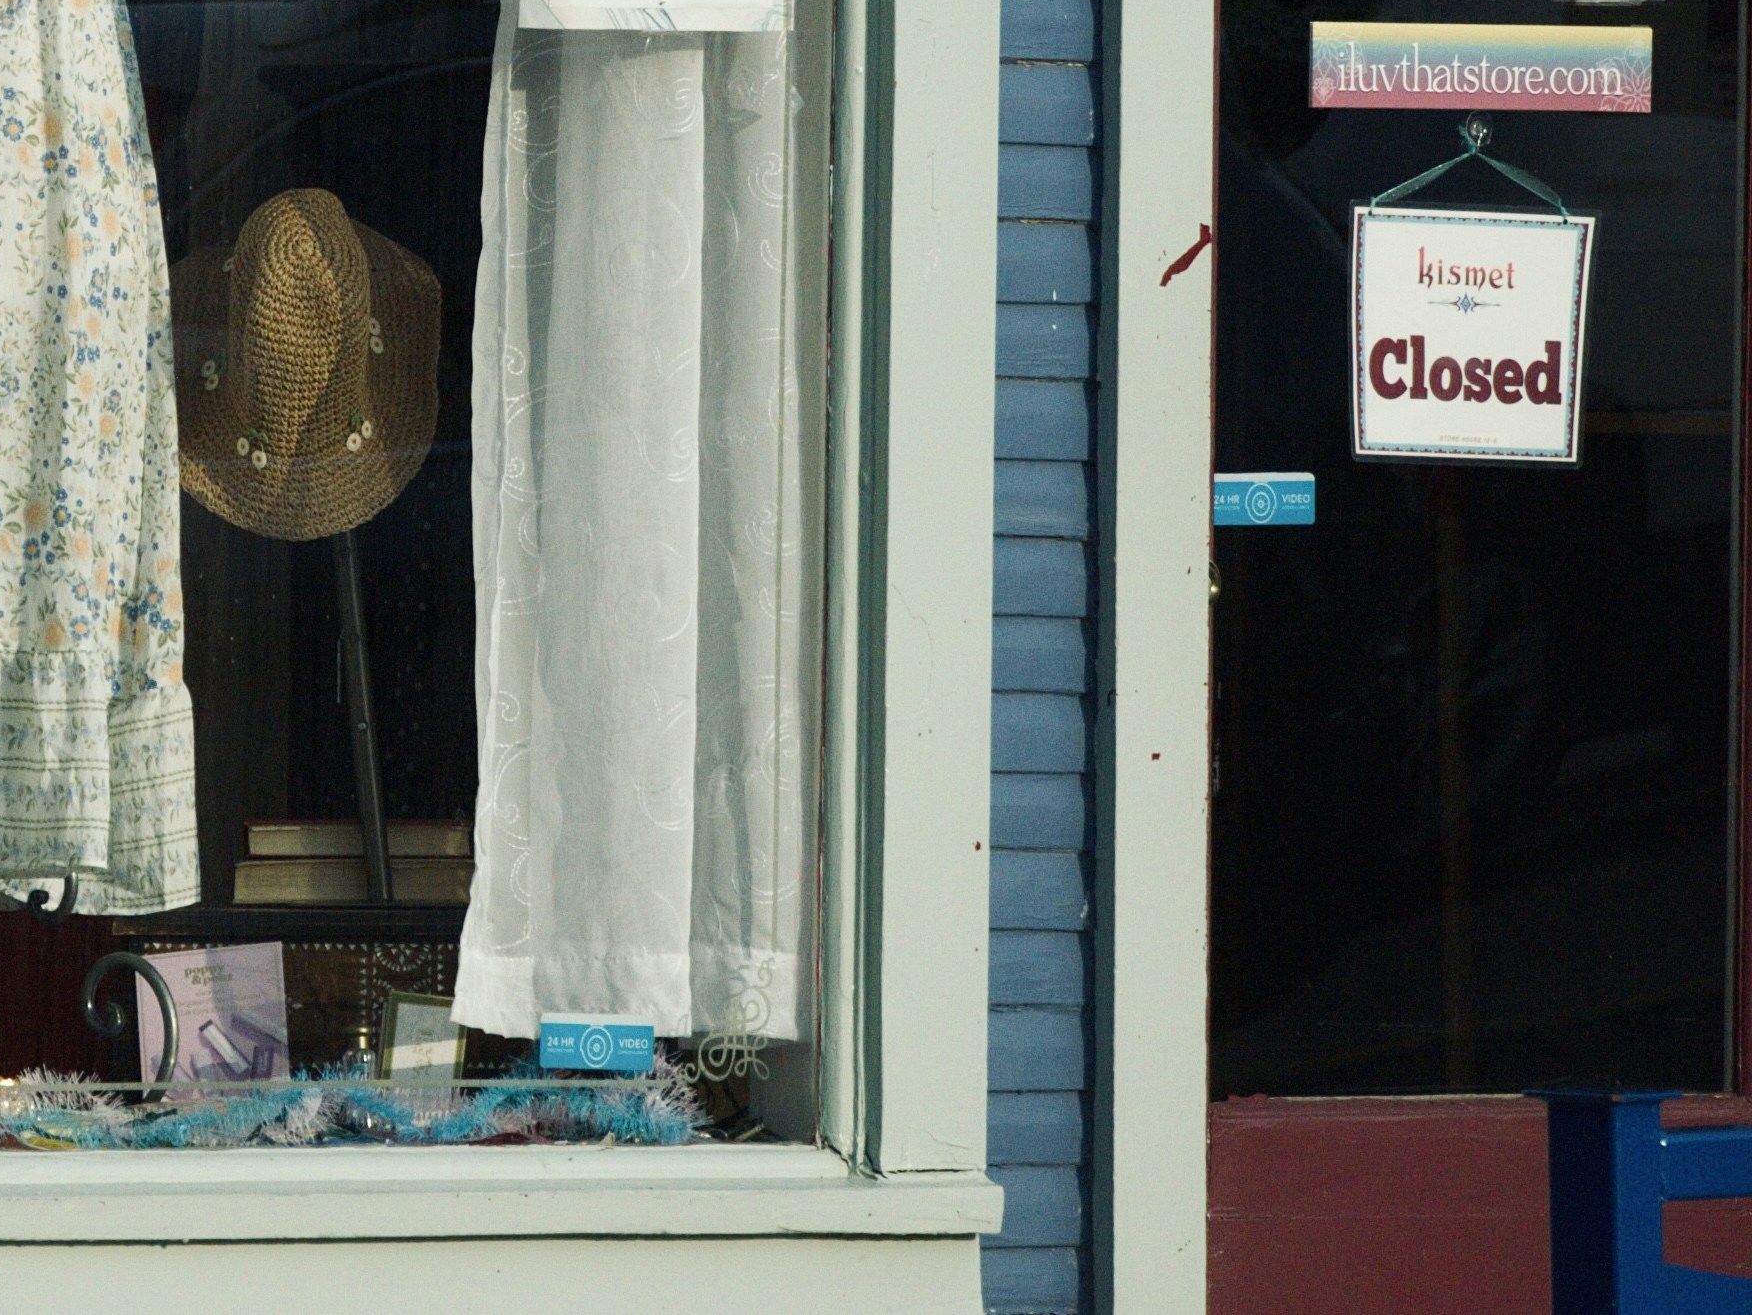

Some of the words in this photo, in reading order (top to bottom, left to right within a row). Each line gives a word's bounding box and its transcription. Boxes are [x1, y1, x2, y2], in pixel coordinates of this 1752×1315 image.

[1338, 41, 1624, 96] iluvthatstore.com
[1417, 245, 1516, 291] kismet
[1368, 334, 1562, 405] Closed
[1214, 494, 1225, 504] 24
[1227, 494, 1240, 504] HR
[1281, 494, 1311, 504] VIDEO
[546, 1036, 558, 1046] 24
[560, 1037, 575, 1047] HR
[618, 1038, 649, 1049] VIDEO
